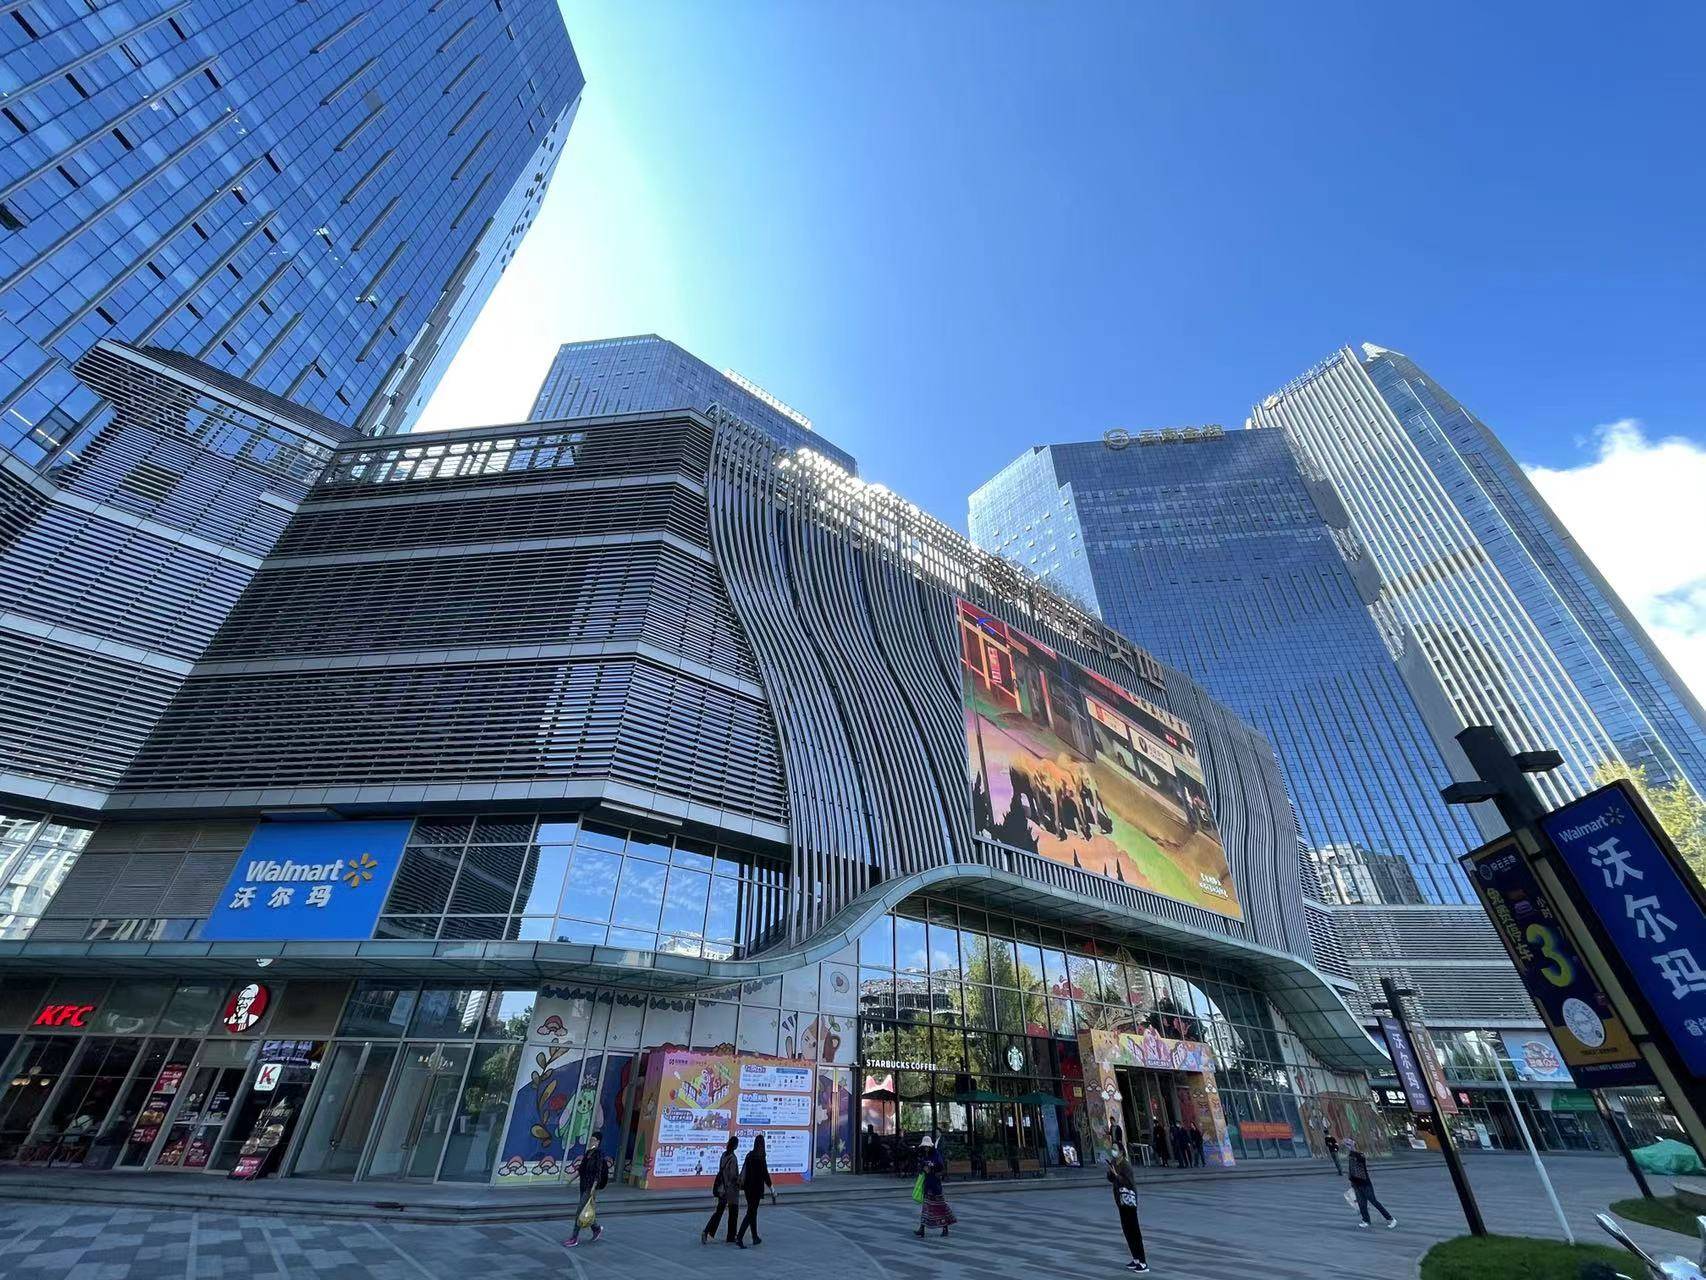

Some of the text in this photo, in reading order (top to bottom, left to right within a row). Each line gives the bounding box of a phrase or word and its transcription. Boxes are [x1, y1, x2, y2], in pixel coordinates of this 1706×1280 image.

[1558, 815, 1609, 843] Walmart
[245, 859, 344, 882] Walmart
[228, 885, 333, 908] 沃尔玛
[1588, 836, 1706, 1000] 沃尔玛
[1526, 923, 1571, 987] 3
[33, 1005, 94, 1026] KFC
[866, 1059, 910, 1069] STARBUCKS
[911, 1062, 937, 1071] COFFEE
[1392, 1033, 1420, 1090] 沃尔玛
